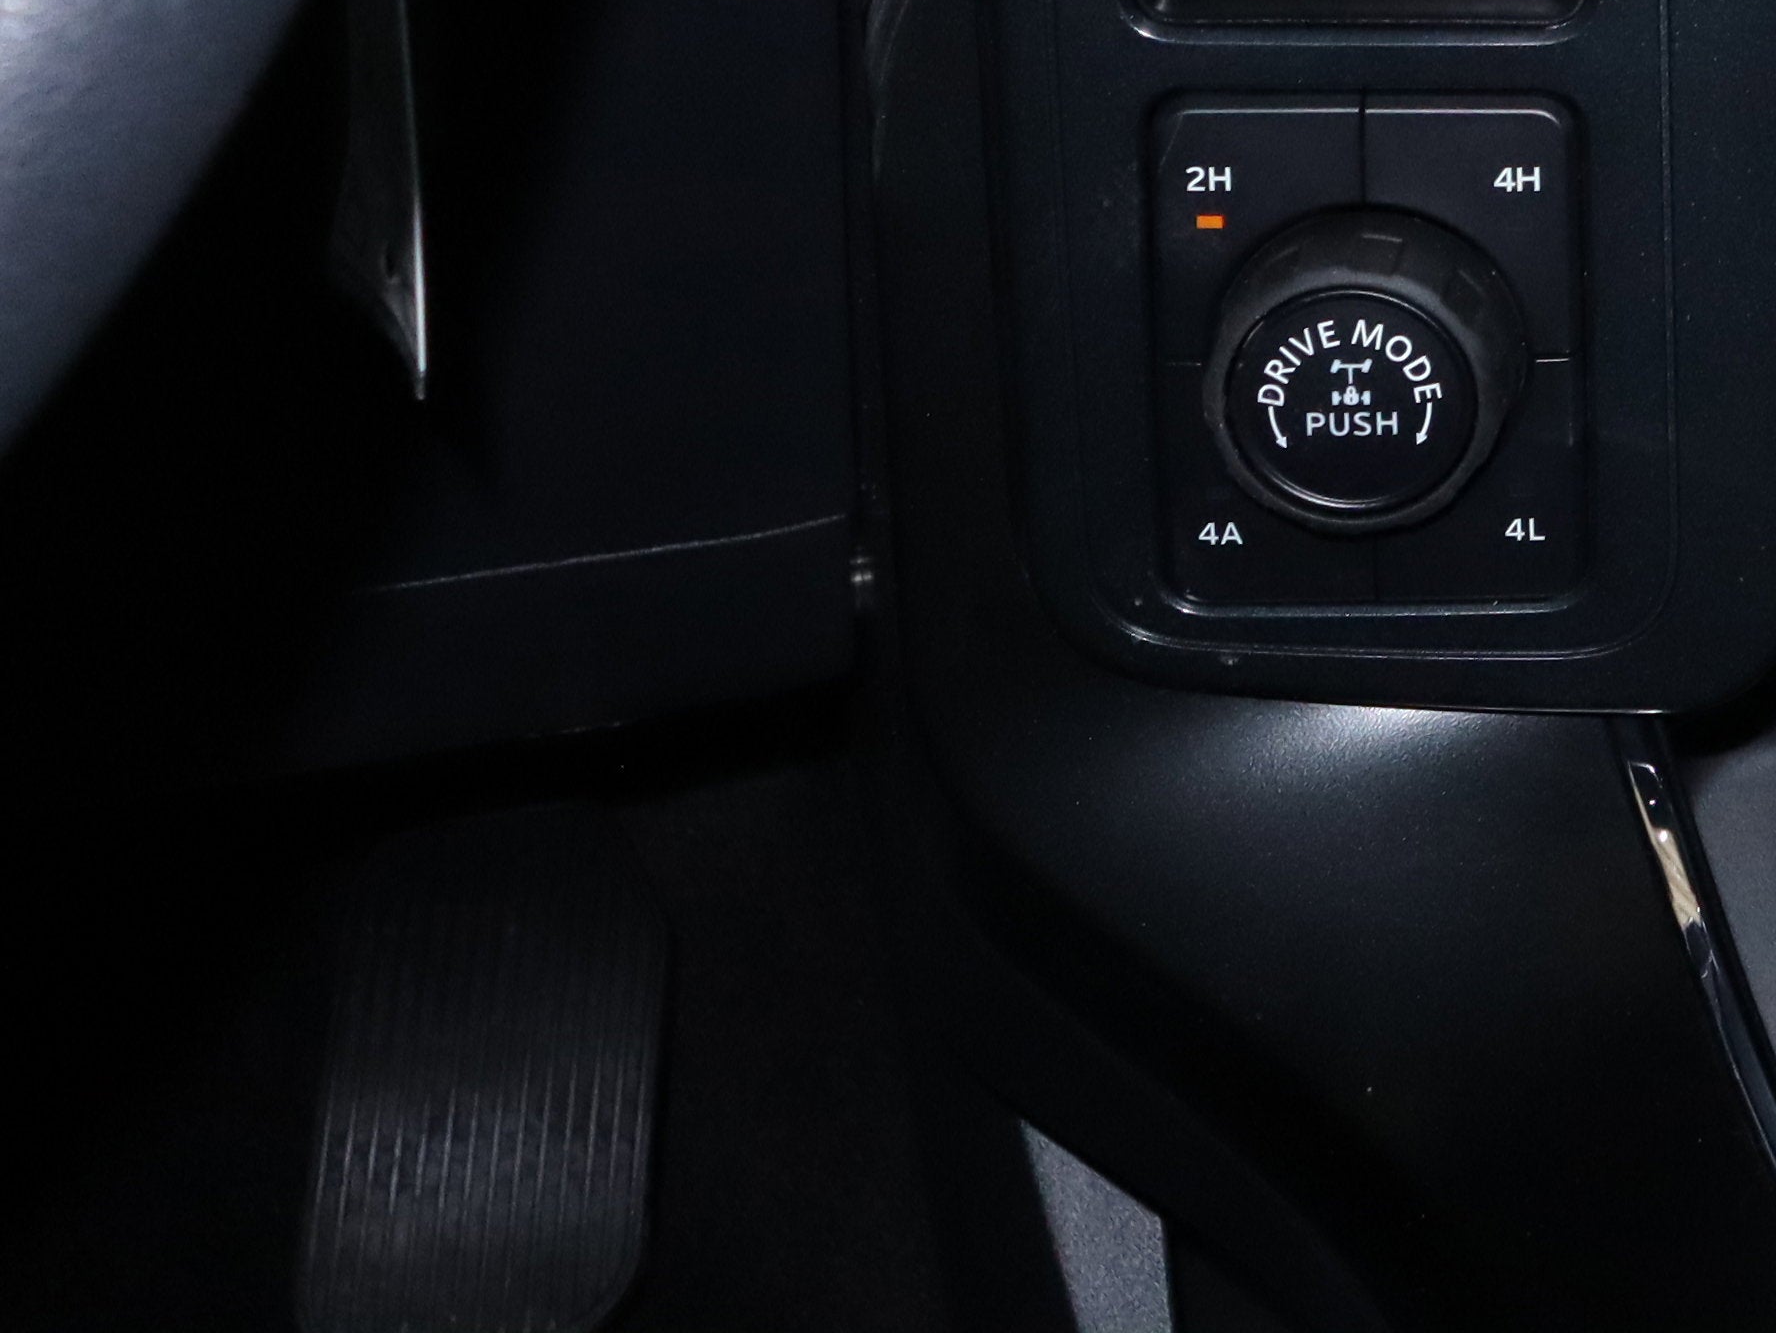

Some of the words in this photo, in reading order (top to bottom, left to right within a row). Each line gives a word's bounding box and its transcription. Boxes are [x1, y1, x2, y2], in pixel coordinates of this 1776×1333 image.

[1185, 165, 1232, 192] 2H
[1493, 165, 1542, 193] 4H
[1257, 319, 1341, 408] DRIVE
[1350, 318, 1443, 405] MODE
[1305, 410, 1399, 437] PUSH
[1198, 521, 1244, 546] 4A
[1504, 517, 1546, 541] 4L
